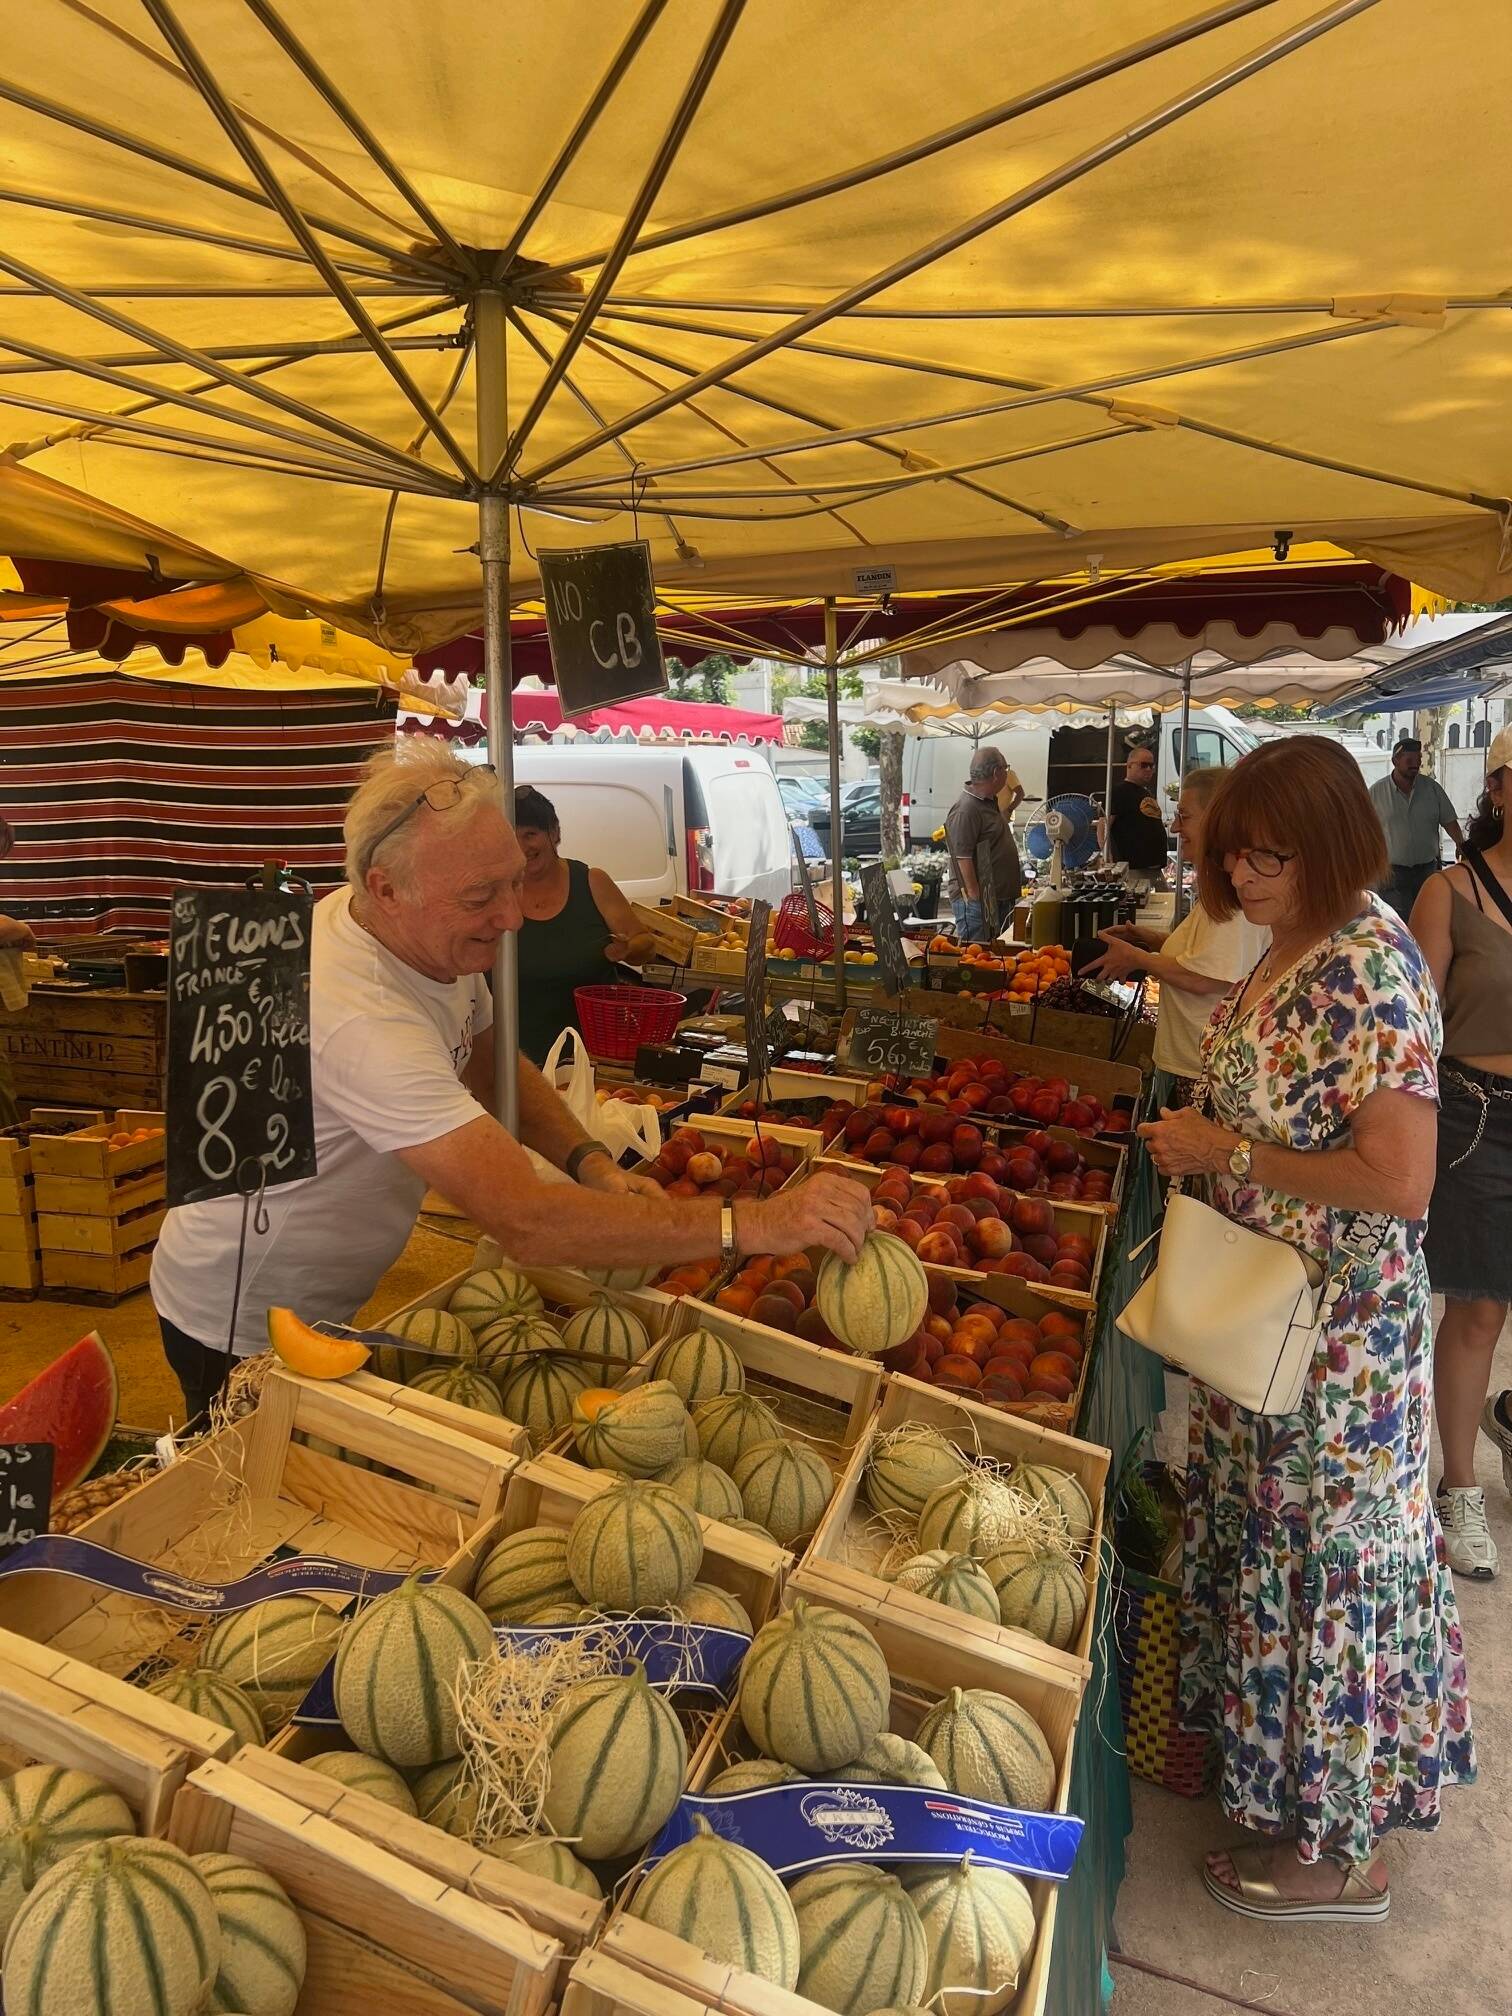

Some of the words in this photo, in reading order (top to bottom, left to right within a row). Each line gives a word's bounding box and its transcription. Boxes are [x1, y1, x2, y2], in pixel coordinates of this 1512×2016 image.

[551, 579, 583, 625] NO
[589, 612, 642, 669] CB
[175, 965, 246, 1002] FRANCE
[196, 1076, 237, 1180] 8
[259, 1113, 296, 1169] 2
[955, 1823, 1012, 1842] PRODUCTEUR
[995, 1824, 1026, 1838] DEPUIS
